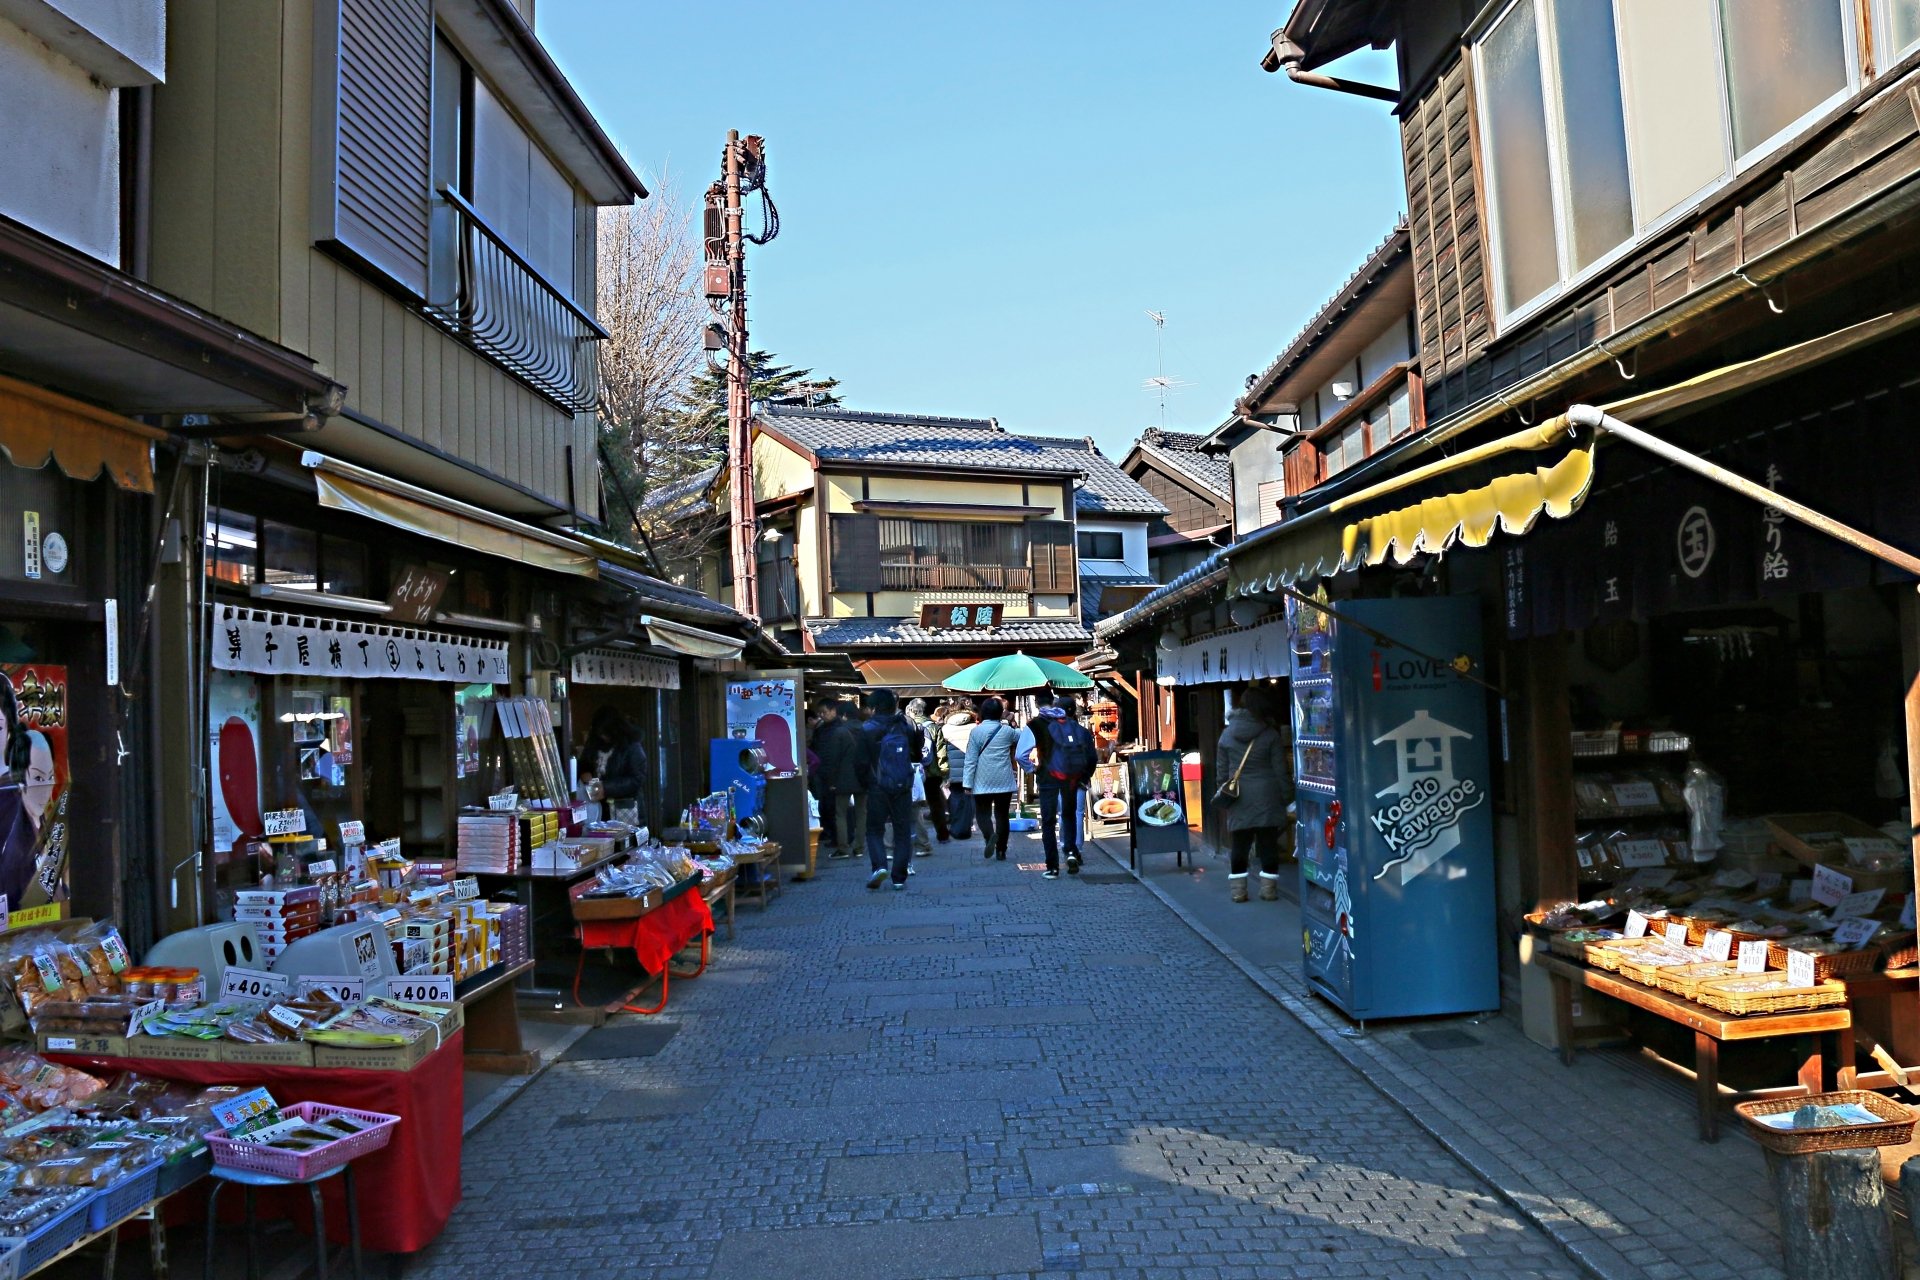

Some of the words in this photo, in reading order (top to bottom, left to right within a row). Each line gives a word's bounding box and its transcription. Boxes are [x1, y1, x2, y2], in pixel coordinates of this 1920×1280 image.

[1386, 659, 1446, 681] LOVE
[1370, 777, 1440, 832] Koedo
[1384, 779, 1477, 851] Kawagoe
